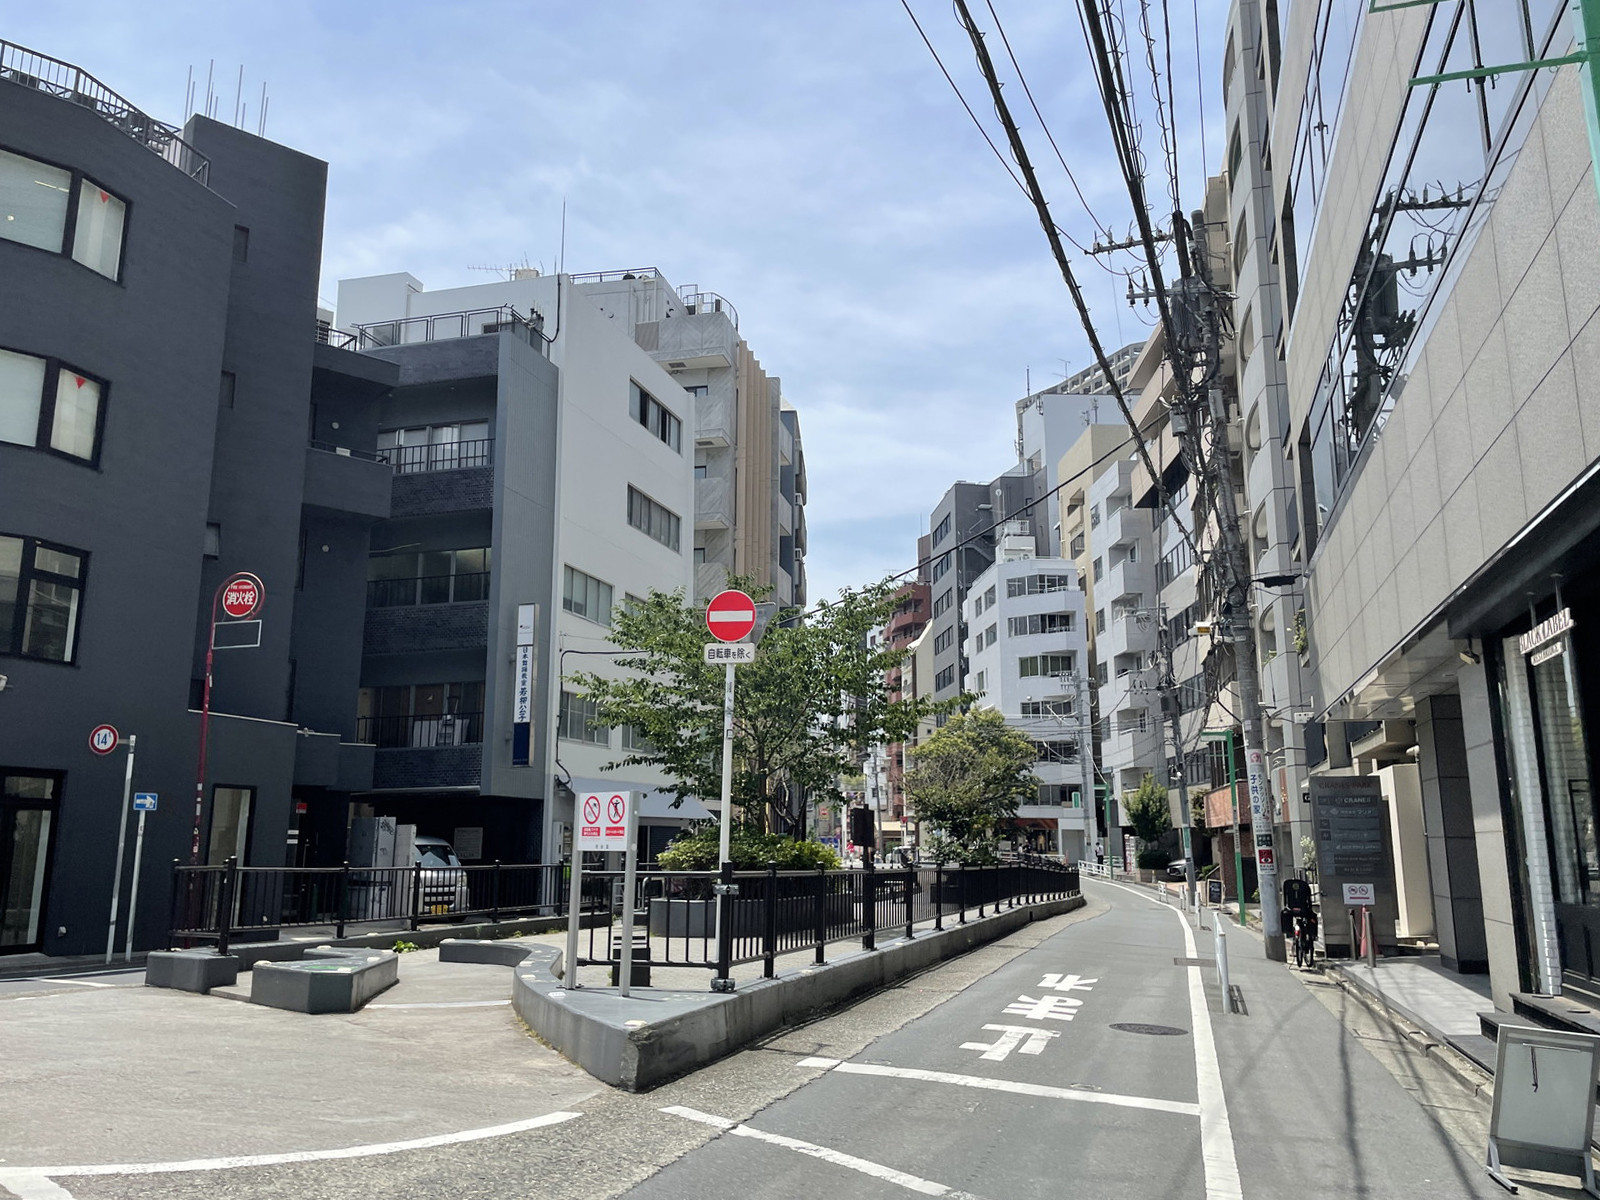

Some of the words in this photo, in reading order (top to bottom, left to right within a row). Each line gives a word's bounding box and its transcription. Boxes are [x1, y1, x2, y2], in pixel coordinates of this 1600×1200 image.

[226, 591, 255, 605] 消火栓
[1519, 623, 1543, 651] BLACK
[707, 647, 751, 659] 自転車を除く
[1250, 774, 1262, 815] 子供の家
[958, 973, 1099, 1062] 止まれ
